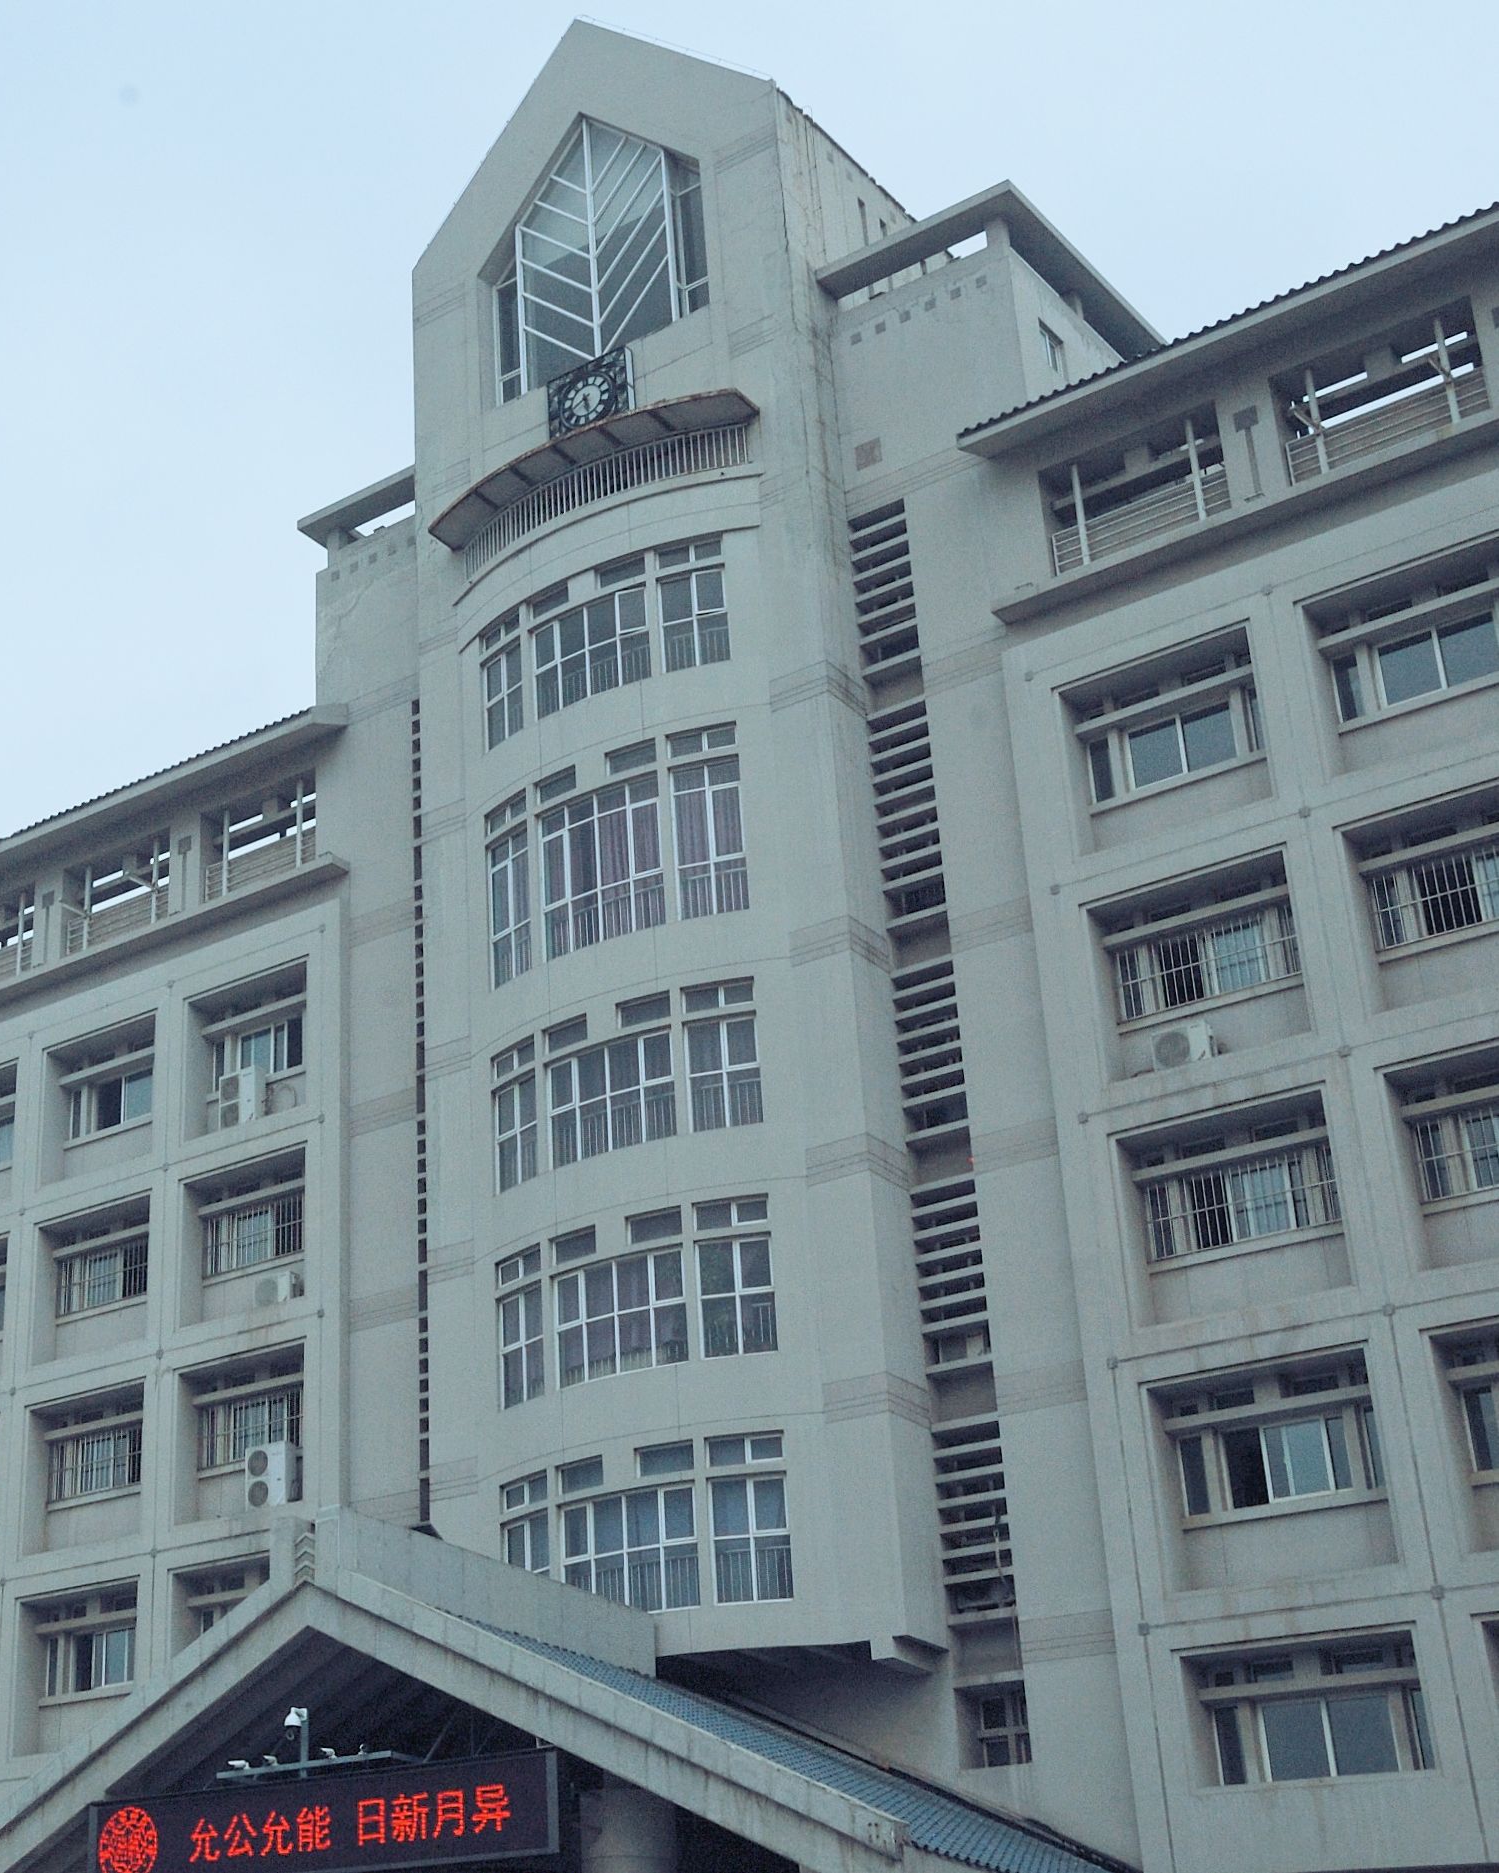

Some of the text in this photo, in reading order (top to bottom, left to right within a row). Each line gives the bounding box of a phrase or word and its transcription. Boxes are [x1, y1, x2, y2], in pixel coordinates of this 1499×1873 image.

[189, 1806, 331, 1863] 允公允能
[357, 1783, 511, 1846] 日新月异
